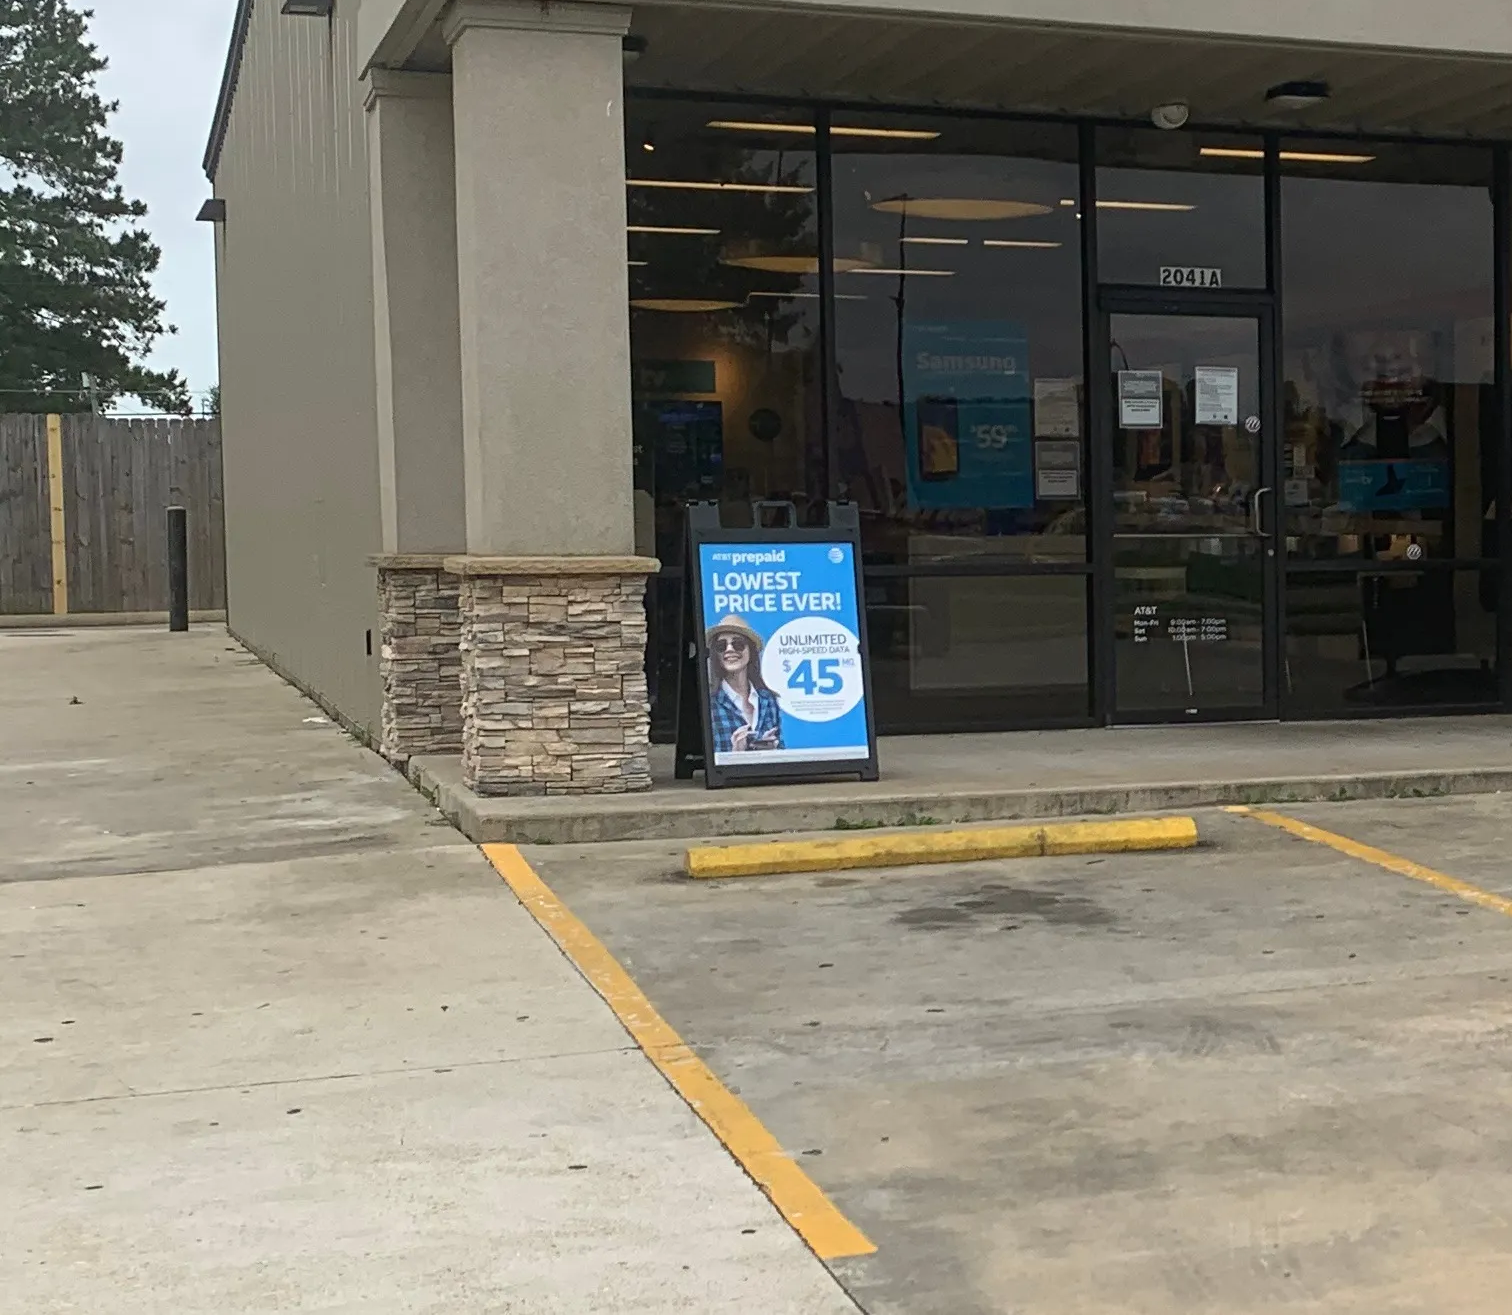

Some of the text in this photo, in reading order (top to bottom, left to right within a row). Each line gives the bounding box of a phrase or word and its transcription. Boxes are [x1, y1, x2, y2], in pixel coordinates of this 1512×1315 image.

[1162, 268, 1220, 287] 2041A
[916, 352, 1017, 375] Samsung
[732, 549, 786, 566] prepaid
[712, 571, 802, 592] LOWEST
[714, 592, 842, 613] PRICE EVER!
[1134, 606, 1158, 616] AT&T
[780, 633, 847, 646] UNLIMITED
[778, 645, 851, 655] HIGH-SPEED DATA
